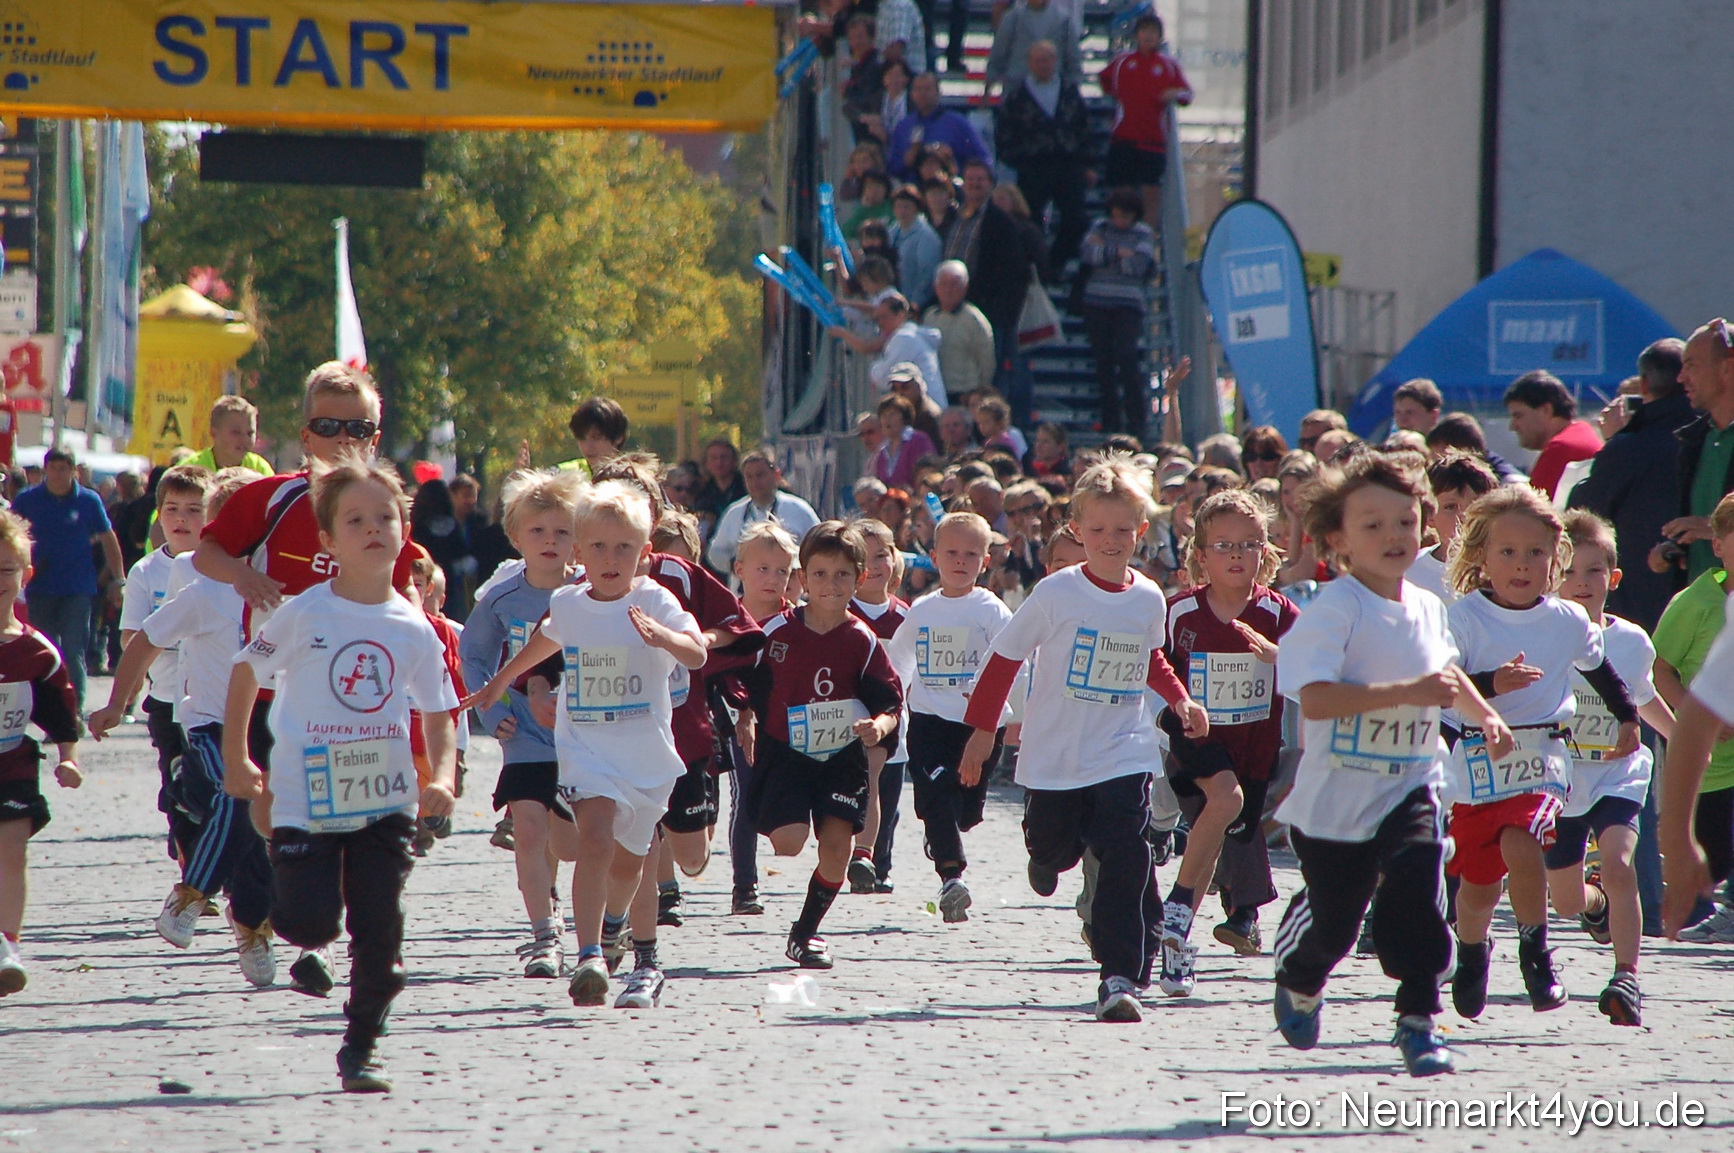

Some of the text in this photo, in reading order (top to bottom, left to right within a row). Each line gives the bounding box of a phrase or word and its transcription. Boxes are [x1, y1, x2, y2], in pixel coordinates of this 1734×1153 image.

[11, 48, 97, 67] Stadtlauf
[153, 15, 469, 91] START
[528, 65, 723, 83] Neumarkter Stadtlauf
[1502, 316, 1577, 343] maxi
[161, 408, 182, 438] A
[932, 631, 953, 643] Luca
[1101, 636, 1140, 654] Thomas
[582, 652, 616, 667] Quirin
[933, 650, 979, 667] 7044
[1075, 654, 1087, 666] K2
[1211, 658, 1249, 673] Lorenz
[1098, 660, 1145, 682] 7128
[584, 674, 643, 697] 7060
[814, 667, 835, 697] 6
[1192, 678, 1202, 690] K2
[1212, 679, 1266, 701] 7138
[811, 707, 845, 721] Moritz
[306, 721, 353, 735] LAUFEN
[359, 724, 382, 736] MIT
[793, 730, 804, 741] K2
[1369, 719, 1433, 746] 7117
[334, 750, 379, 767] Fabian
[1474, 767, 1487, 781] K2
[311, 778, 325, 792] K2
[338, 771, 409, 801] 7104
